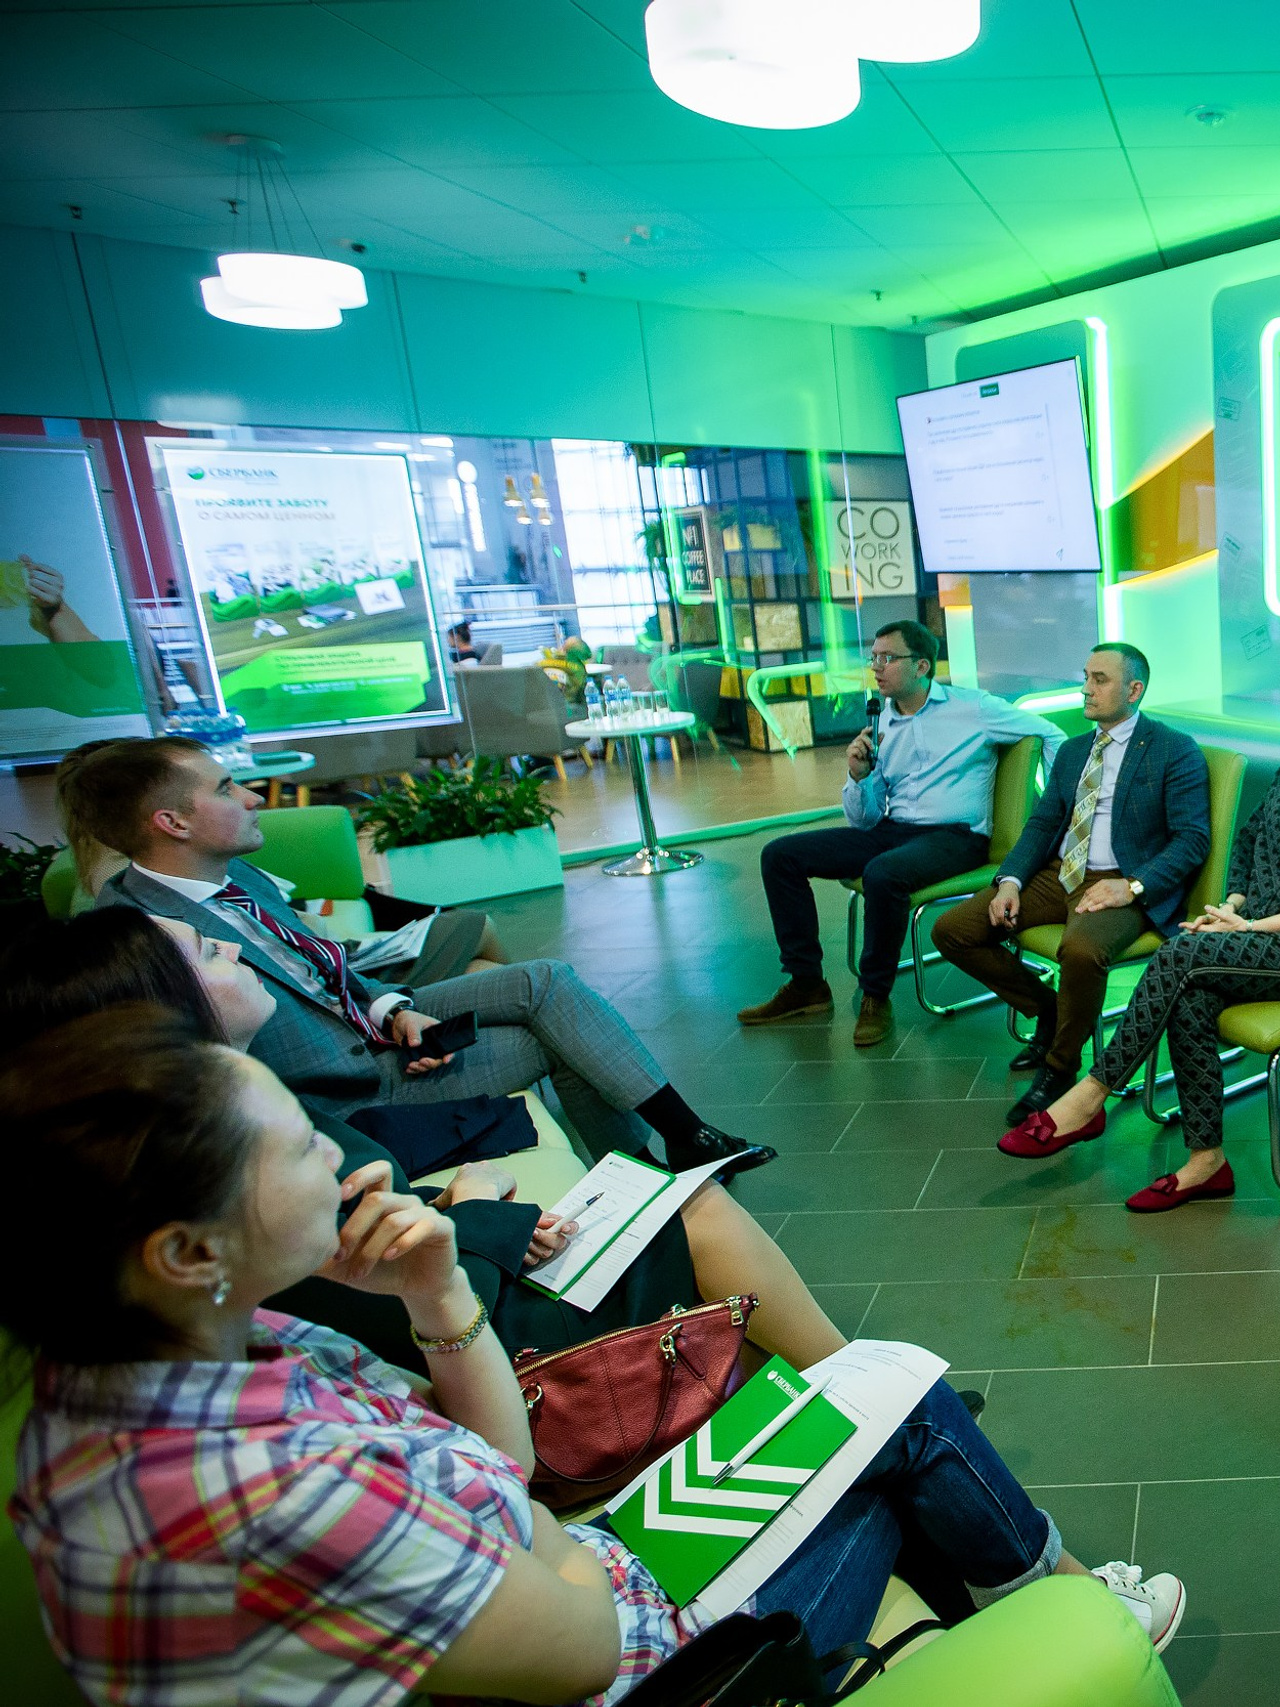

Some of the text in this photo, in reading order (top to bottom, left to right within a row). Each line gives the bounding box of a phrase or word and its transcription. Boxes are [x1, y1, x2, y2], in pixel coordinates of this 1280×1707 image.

[836, 506, 900, 540] CO
[840, 541, 902, 561] WORK
[686, 568, 706, 585] PLACE
[844, 561, 904, 592] ING
